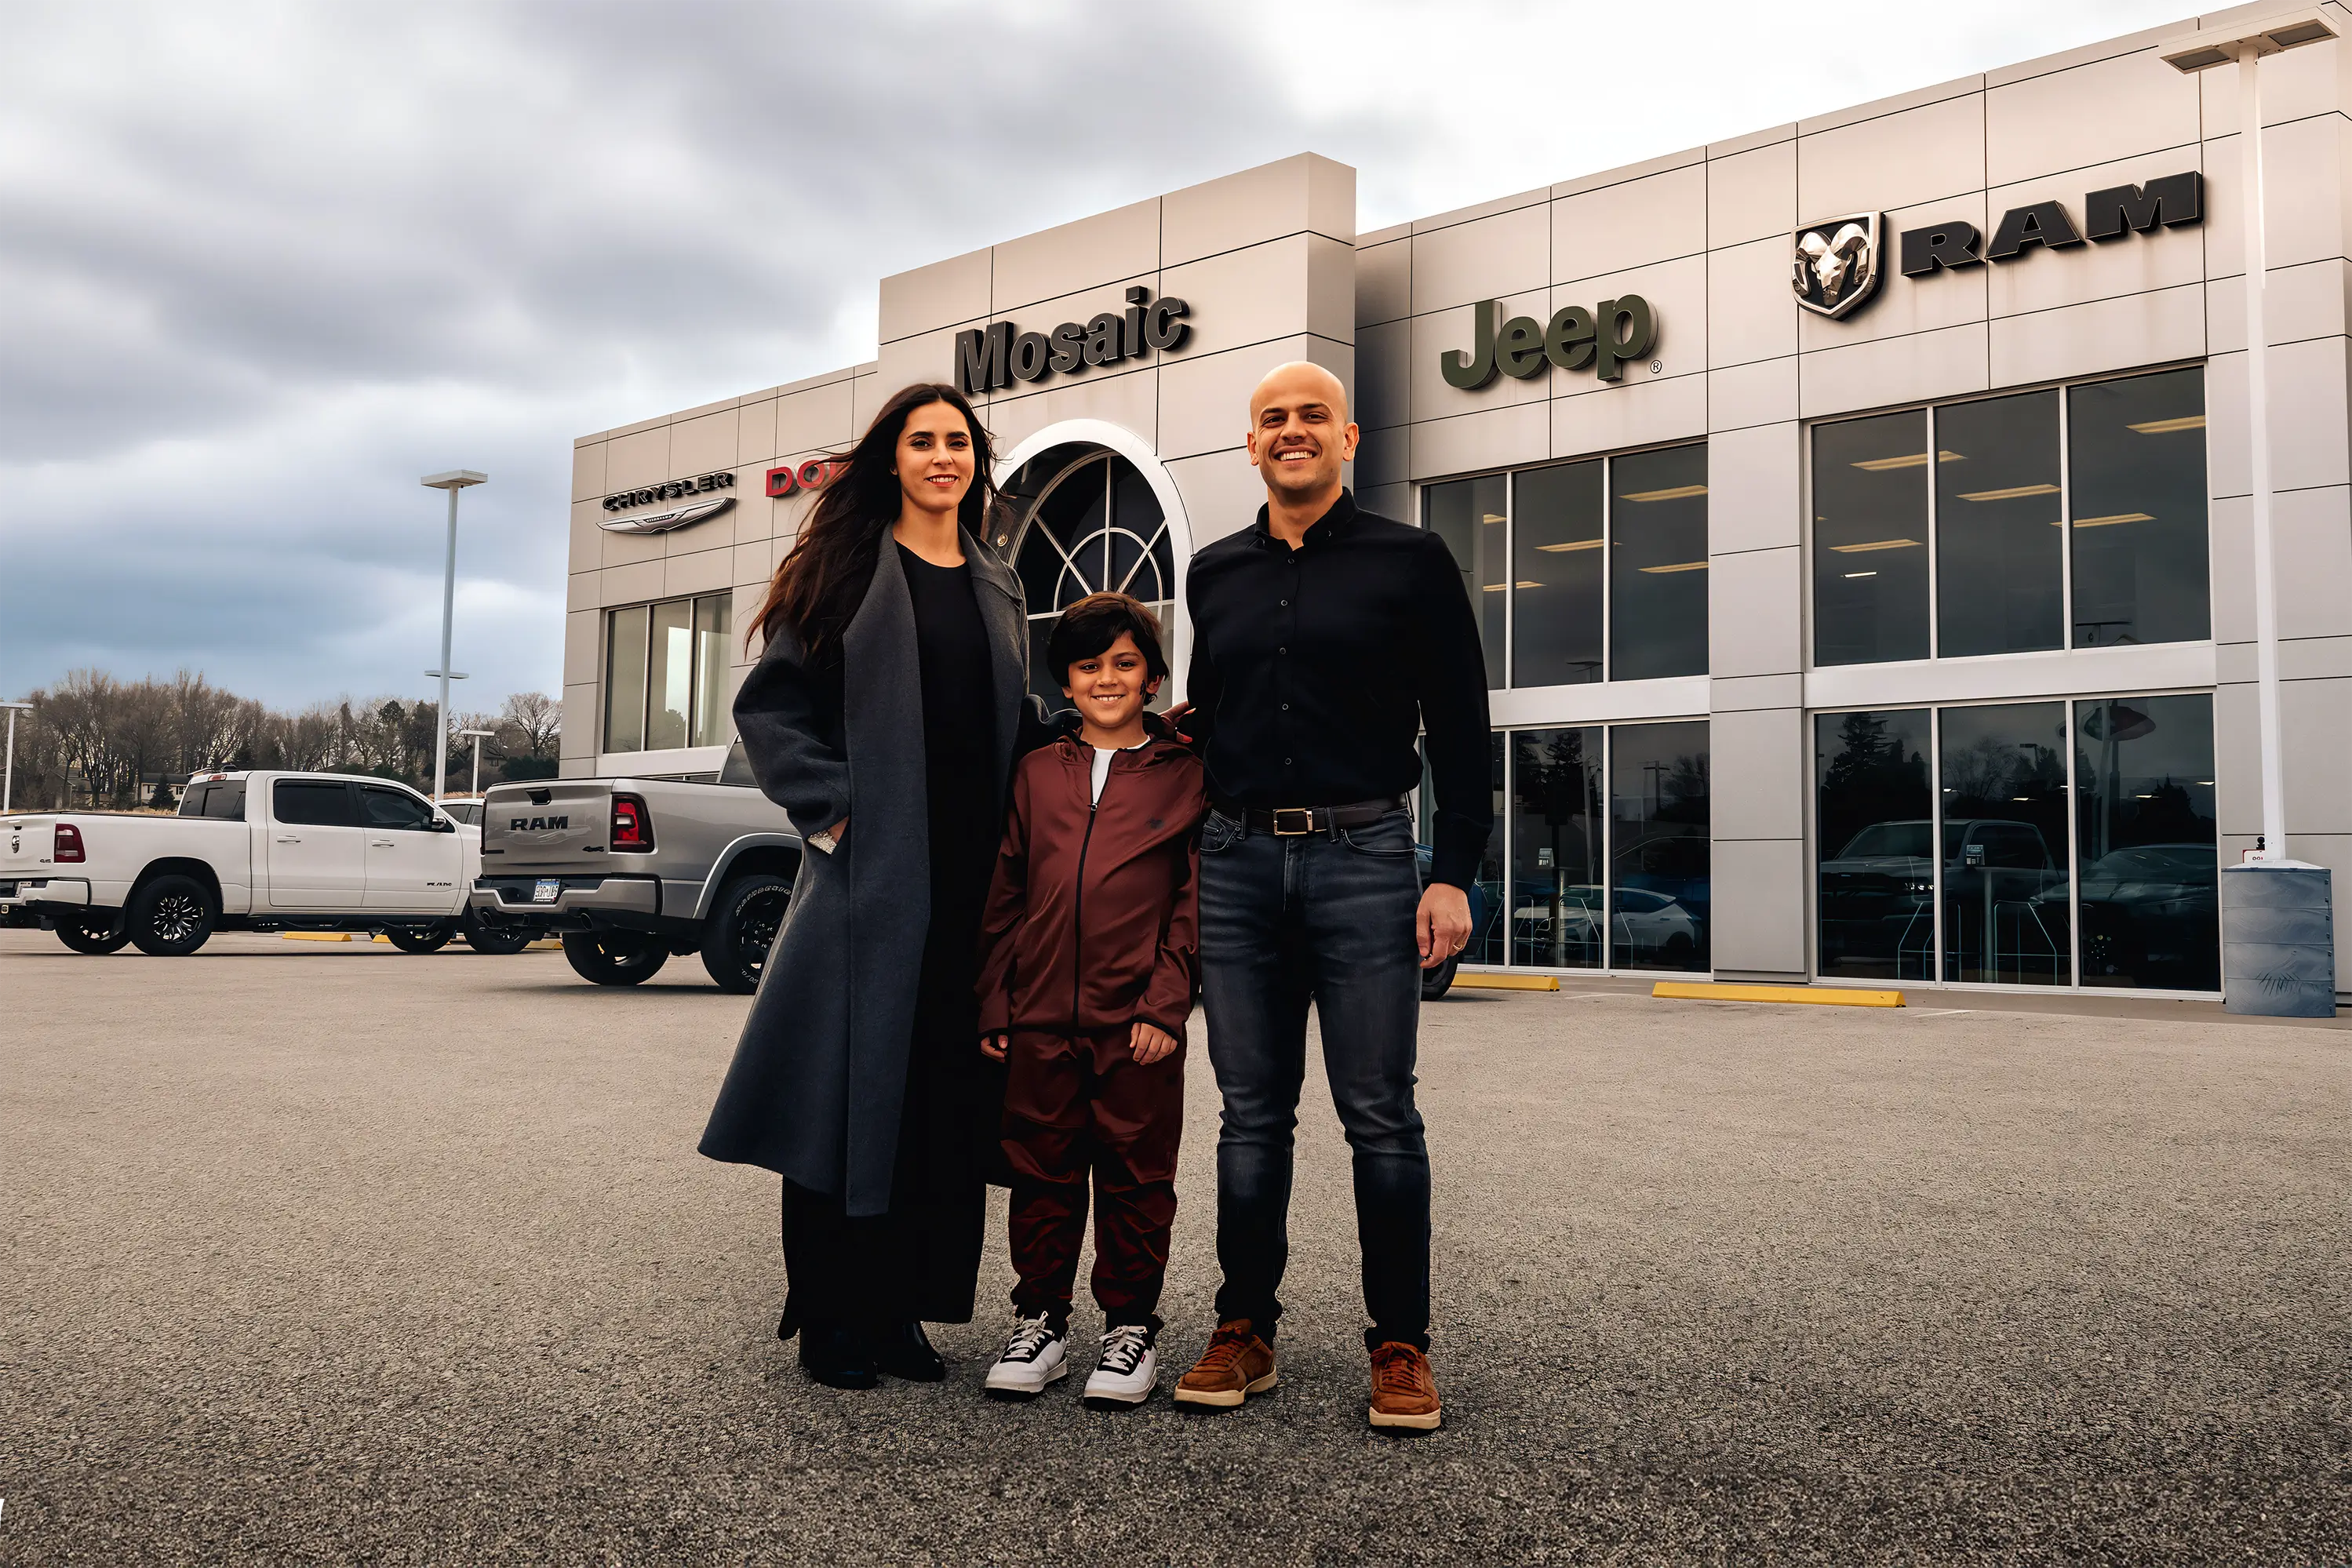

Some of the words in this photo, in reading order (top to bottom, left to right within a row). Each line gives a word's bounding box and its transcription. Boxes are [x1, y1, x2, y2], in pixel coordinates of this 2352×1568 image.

[1900, 169, 2203, 278] RAM
[954, 285, 1191, 395] Mosaic
[1440, 294, 1659, 390] Jeep
[603, 471, 734, 511] CHRYSLER
[511, 816, 569, 831] RAM
